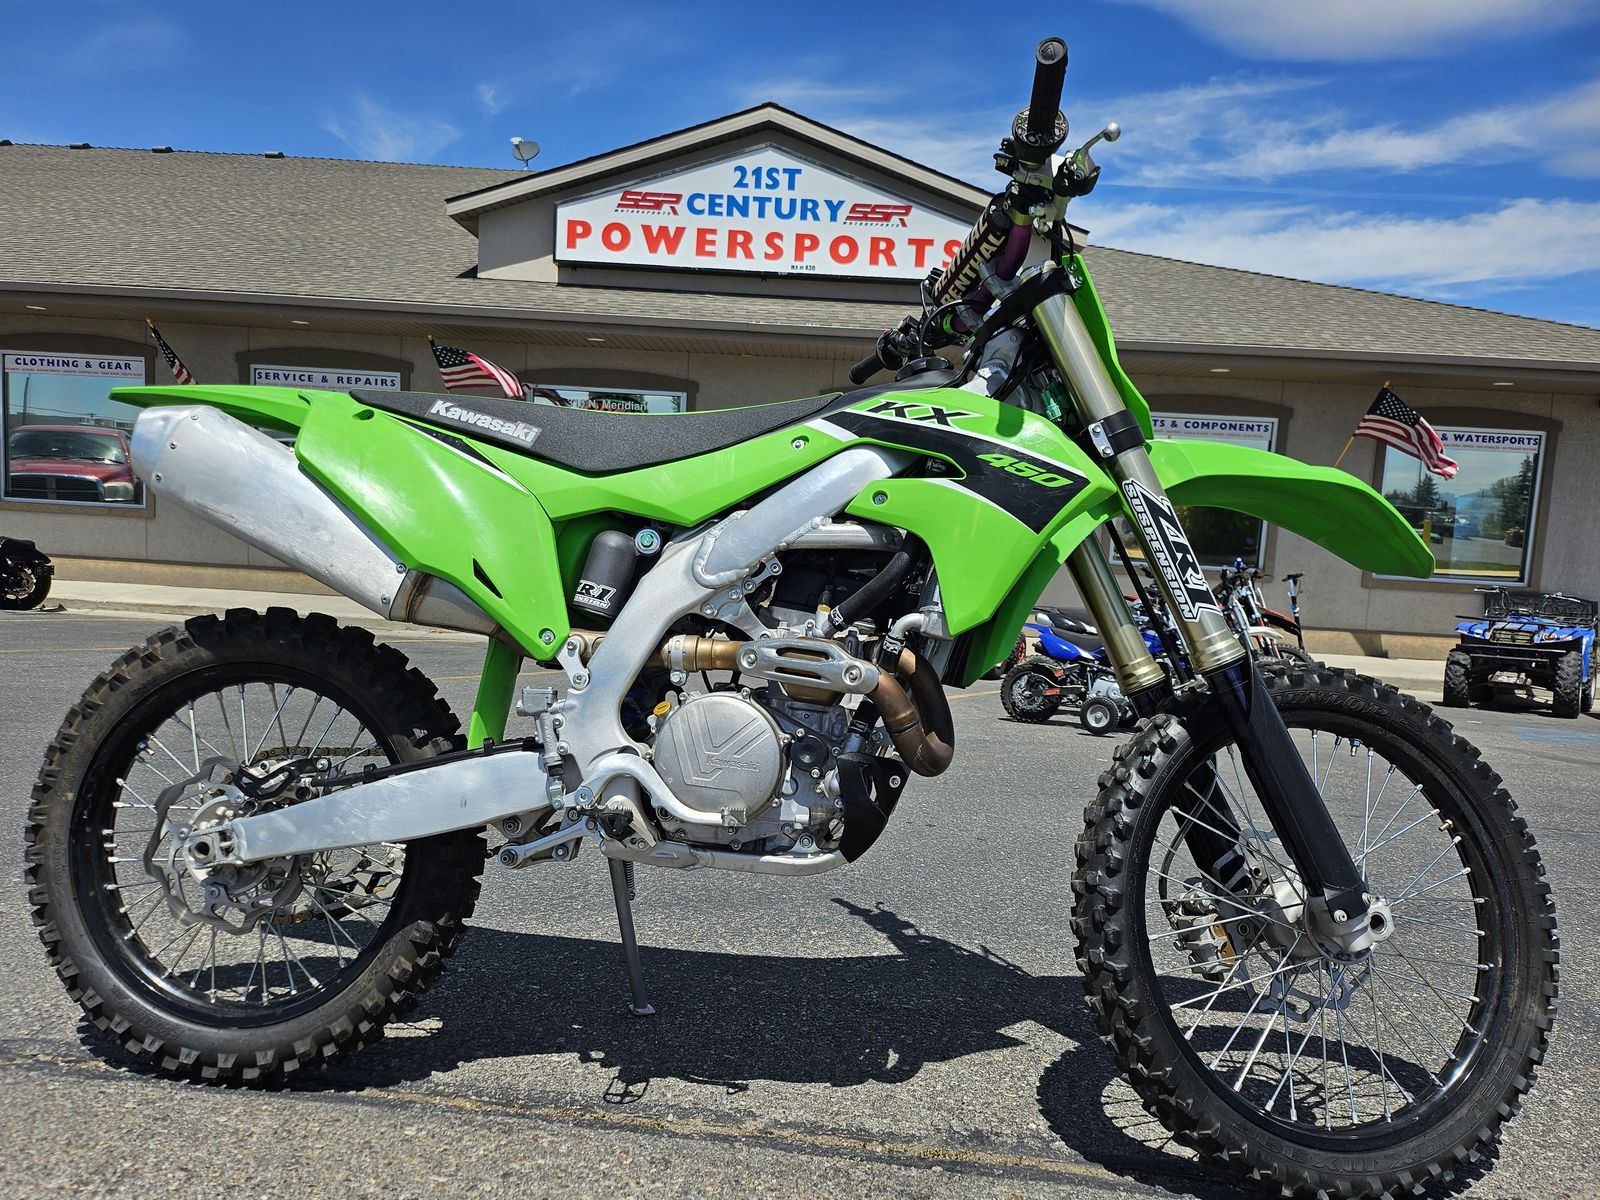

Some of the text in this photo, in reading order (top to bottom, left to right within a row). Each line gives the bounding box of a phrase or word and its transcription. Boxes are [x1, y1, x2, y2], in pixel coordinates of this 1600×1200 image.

[733, 165, 803, 191] 21ST
[616, 190, 683, 216] SSR
[686, 192, 846, 223] CENTURY
[845, 203, 913, 228] SSR
[566, 219, 963, 269] POWERSPORTS
[14, 357, 132, 370] CLOTHING & GEAR
[256, 371, 314, 383] SERVICE
[320, 375, 329, 383] &
[336, 376, 397, 387] REPAIRS
[602, 400, 647, 411] Meridian
[866, 400, 982, 429] KX
[430, 400, 540, 443] Kawasaki
[1170, 420, 1178, 428] &
[1184, 421, 1269, 432] COMPONENTS
[1440, 433, 1539, 446] & WATERSPORTS
[975, 453, 1074, 488] 450
[1124, 482, 1193, 619] SUSPENSION
[577, 582, 613, 602] R1
[705, 755, 760, 773] Kawasaki
